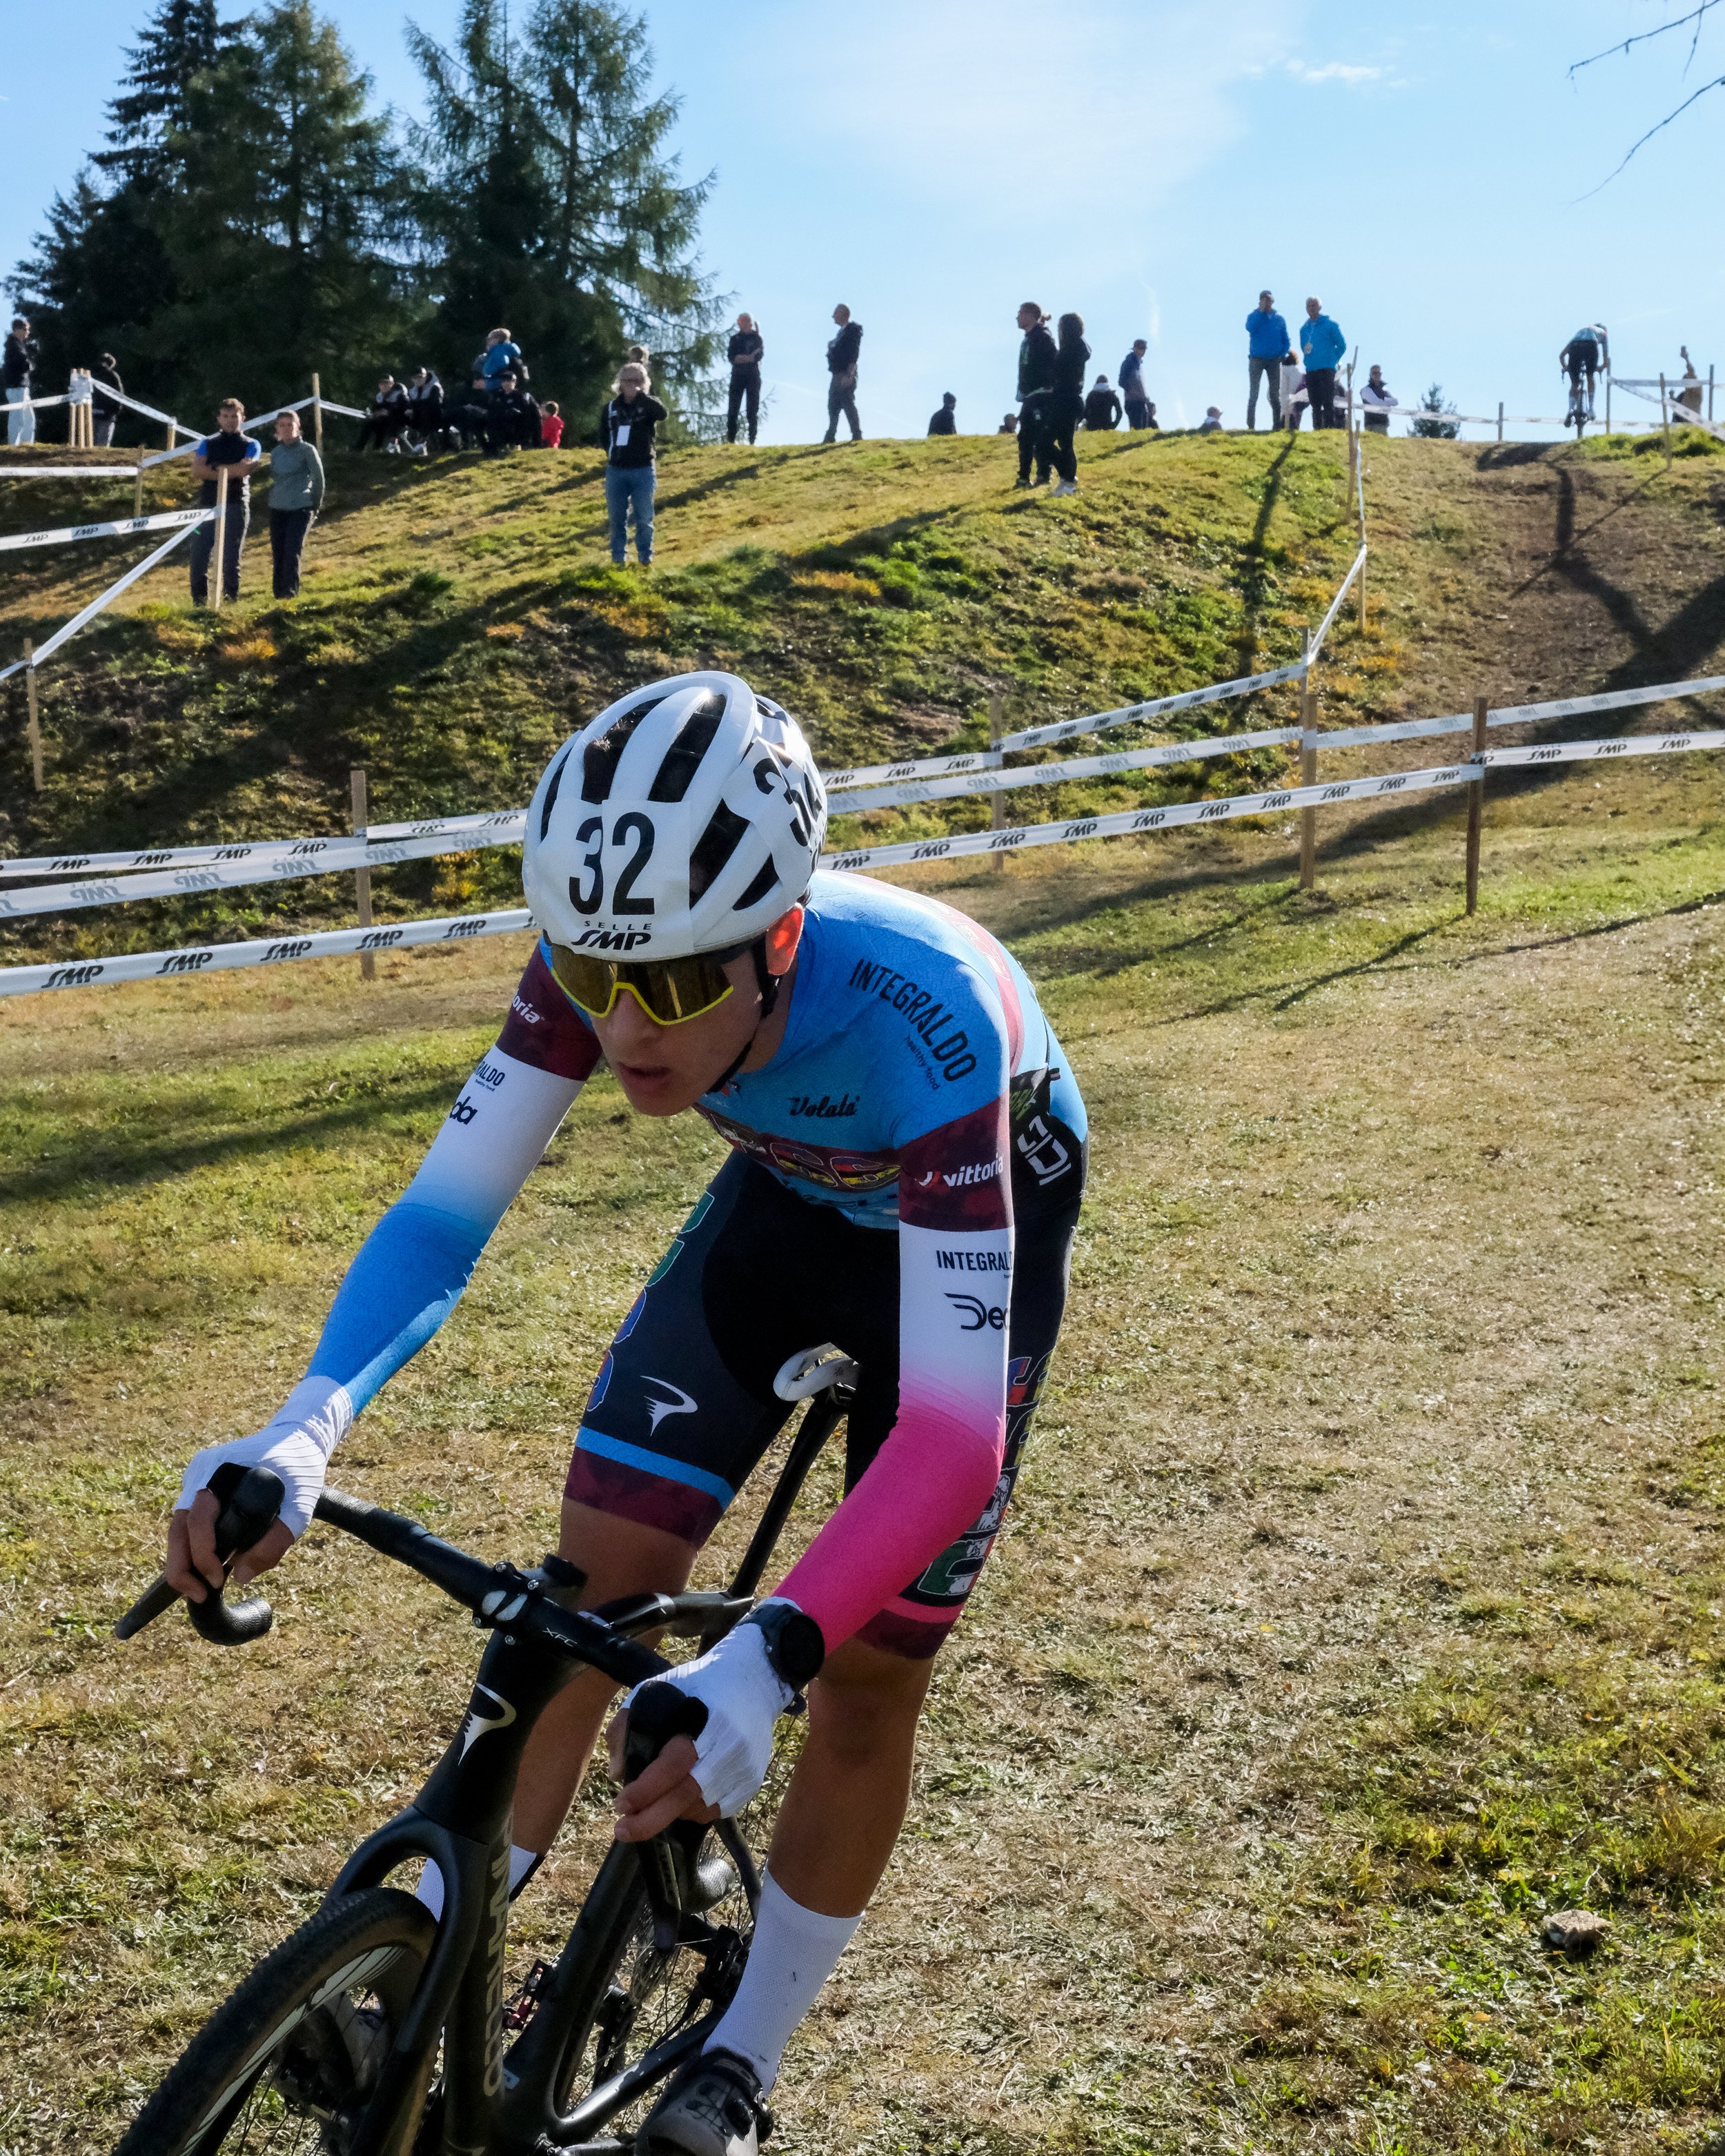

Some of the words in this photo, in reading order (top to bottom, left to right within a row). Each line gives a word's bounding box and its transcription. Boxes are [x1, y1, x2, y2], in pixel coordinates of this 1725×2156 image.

[1527, 749, 1561, 761] SMP
[1594, 744, 1628, 755] SMP
[1658, 738, 1691, 750] SMP
[884, 767, 916, 779] SMP
[945, 759, 974, 771] SMP
[832, 856, 871, 871] SMP
[910, 843, 950, 860] SMP
[987, 833, 1026, 849] SMP
[1061, 822, 1098, 839] SMP
[1130, 813, 1165, 829] SMP
[1196, 804, 1230, 819] SMP
[1260, 795, 1291, 809] SMP
[1319, 786, 1350, 800] SMP
[1377, 778, 1406, 791] SMP
[45, 859, 90, 871] SMP
[129, 854, 172, 866] SMP
[211, 849, 251, 860] SMP
[288, 843, 327, 856] SMP
[569, 812, 655, 916] 32
[571, 930, 651, 951] SMP
[584, 921, 652, 930] SELLE
[41, 965, 103, 989] SMP
[156, 952, 213, 974] SMP
[260, 940, 313, 962] SMP
[355, 930, 404, 950] SMP
[443, 920, 486, 938] SMP
[512, 989, 541, 1025] oria
[847, 958, 976, 1082] INTEGRALDO
[449, 1096, 478, 1125] da
[943, 1153, 1003, 1187] vittoria
